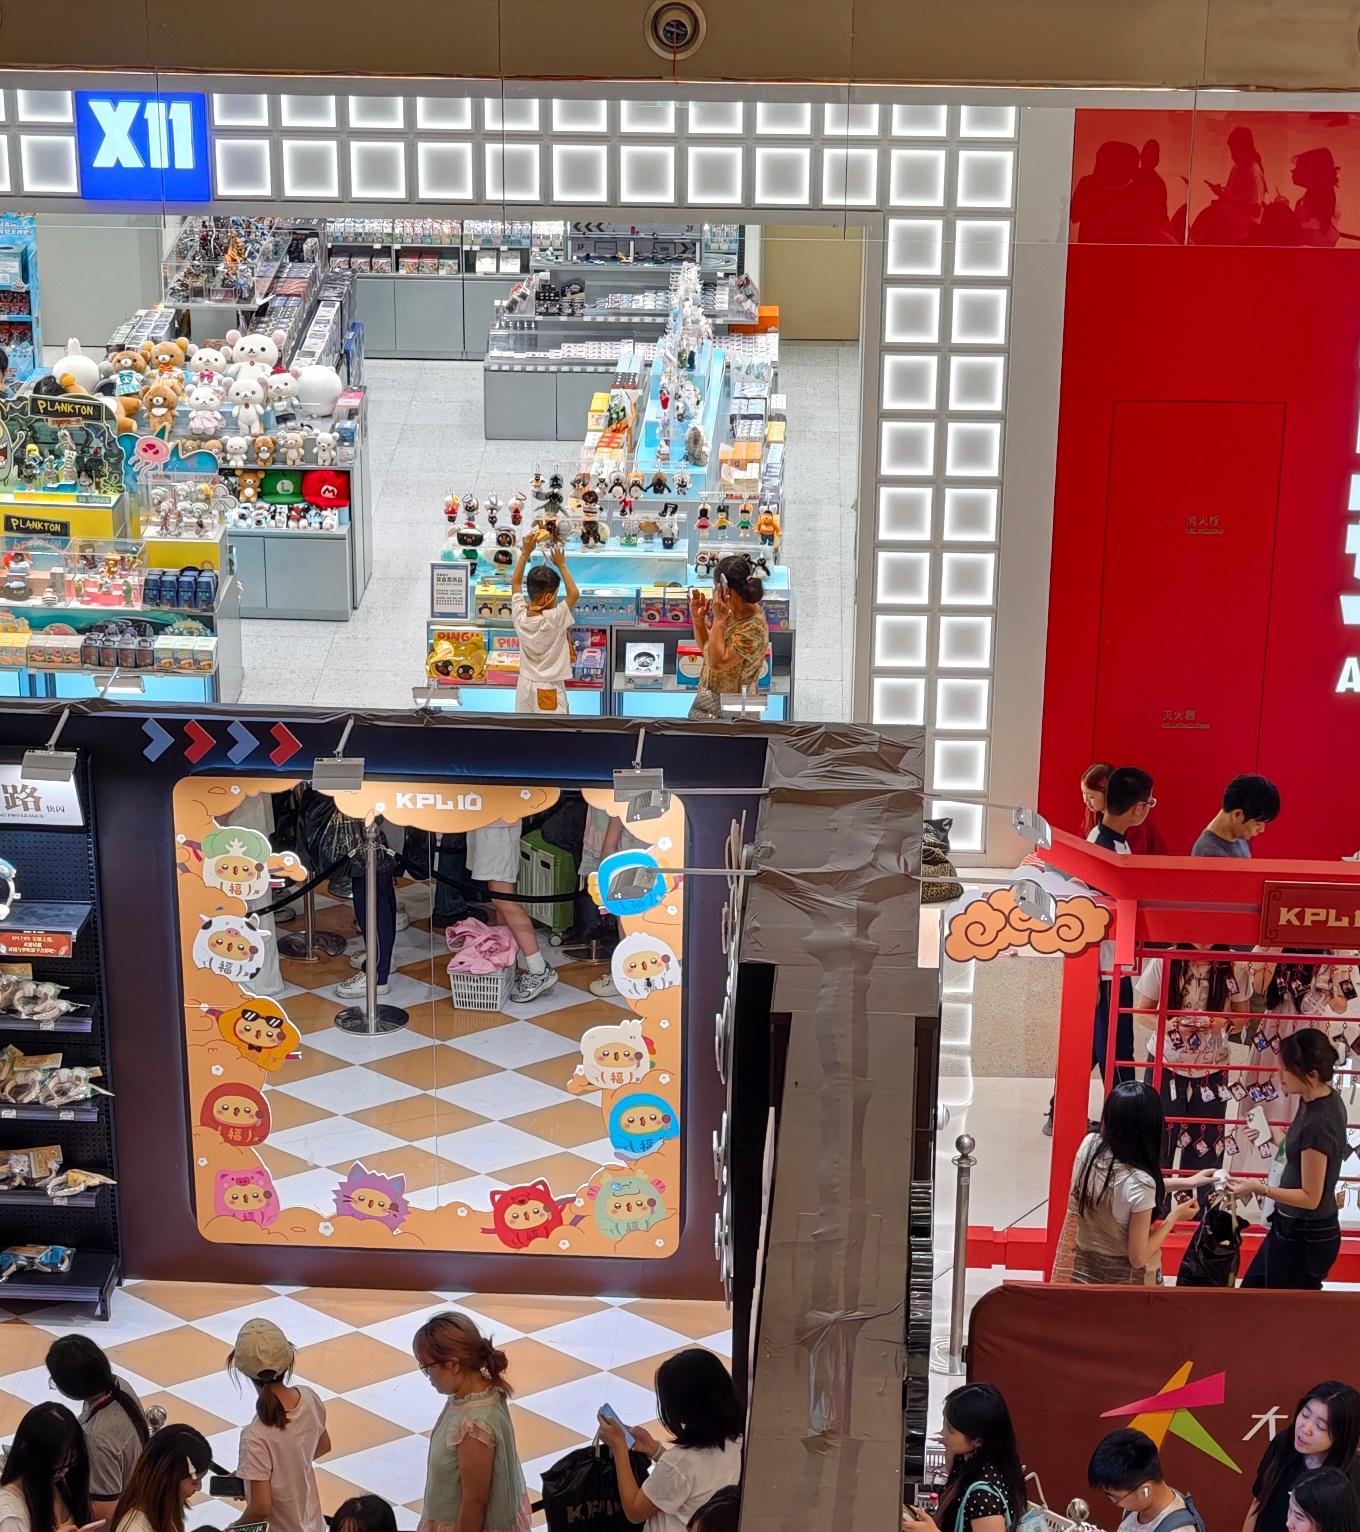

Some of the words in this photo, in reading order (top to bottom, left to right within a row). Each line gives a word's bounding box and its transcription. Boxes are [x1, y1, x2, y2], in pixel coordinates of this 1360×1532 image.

[89, 98, 196, 170] X11
[37, 399, 95, 417] PLANKTON
[10, 518, 61, 533] PLANKTON
